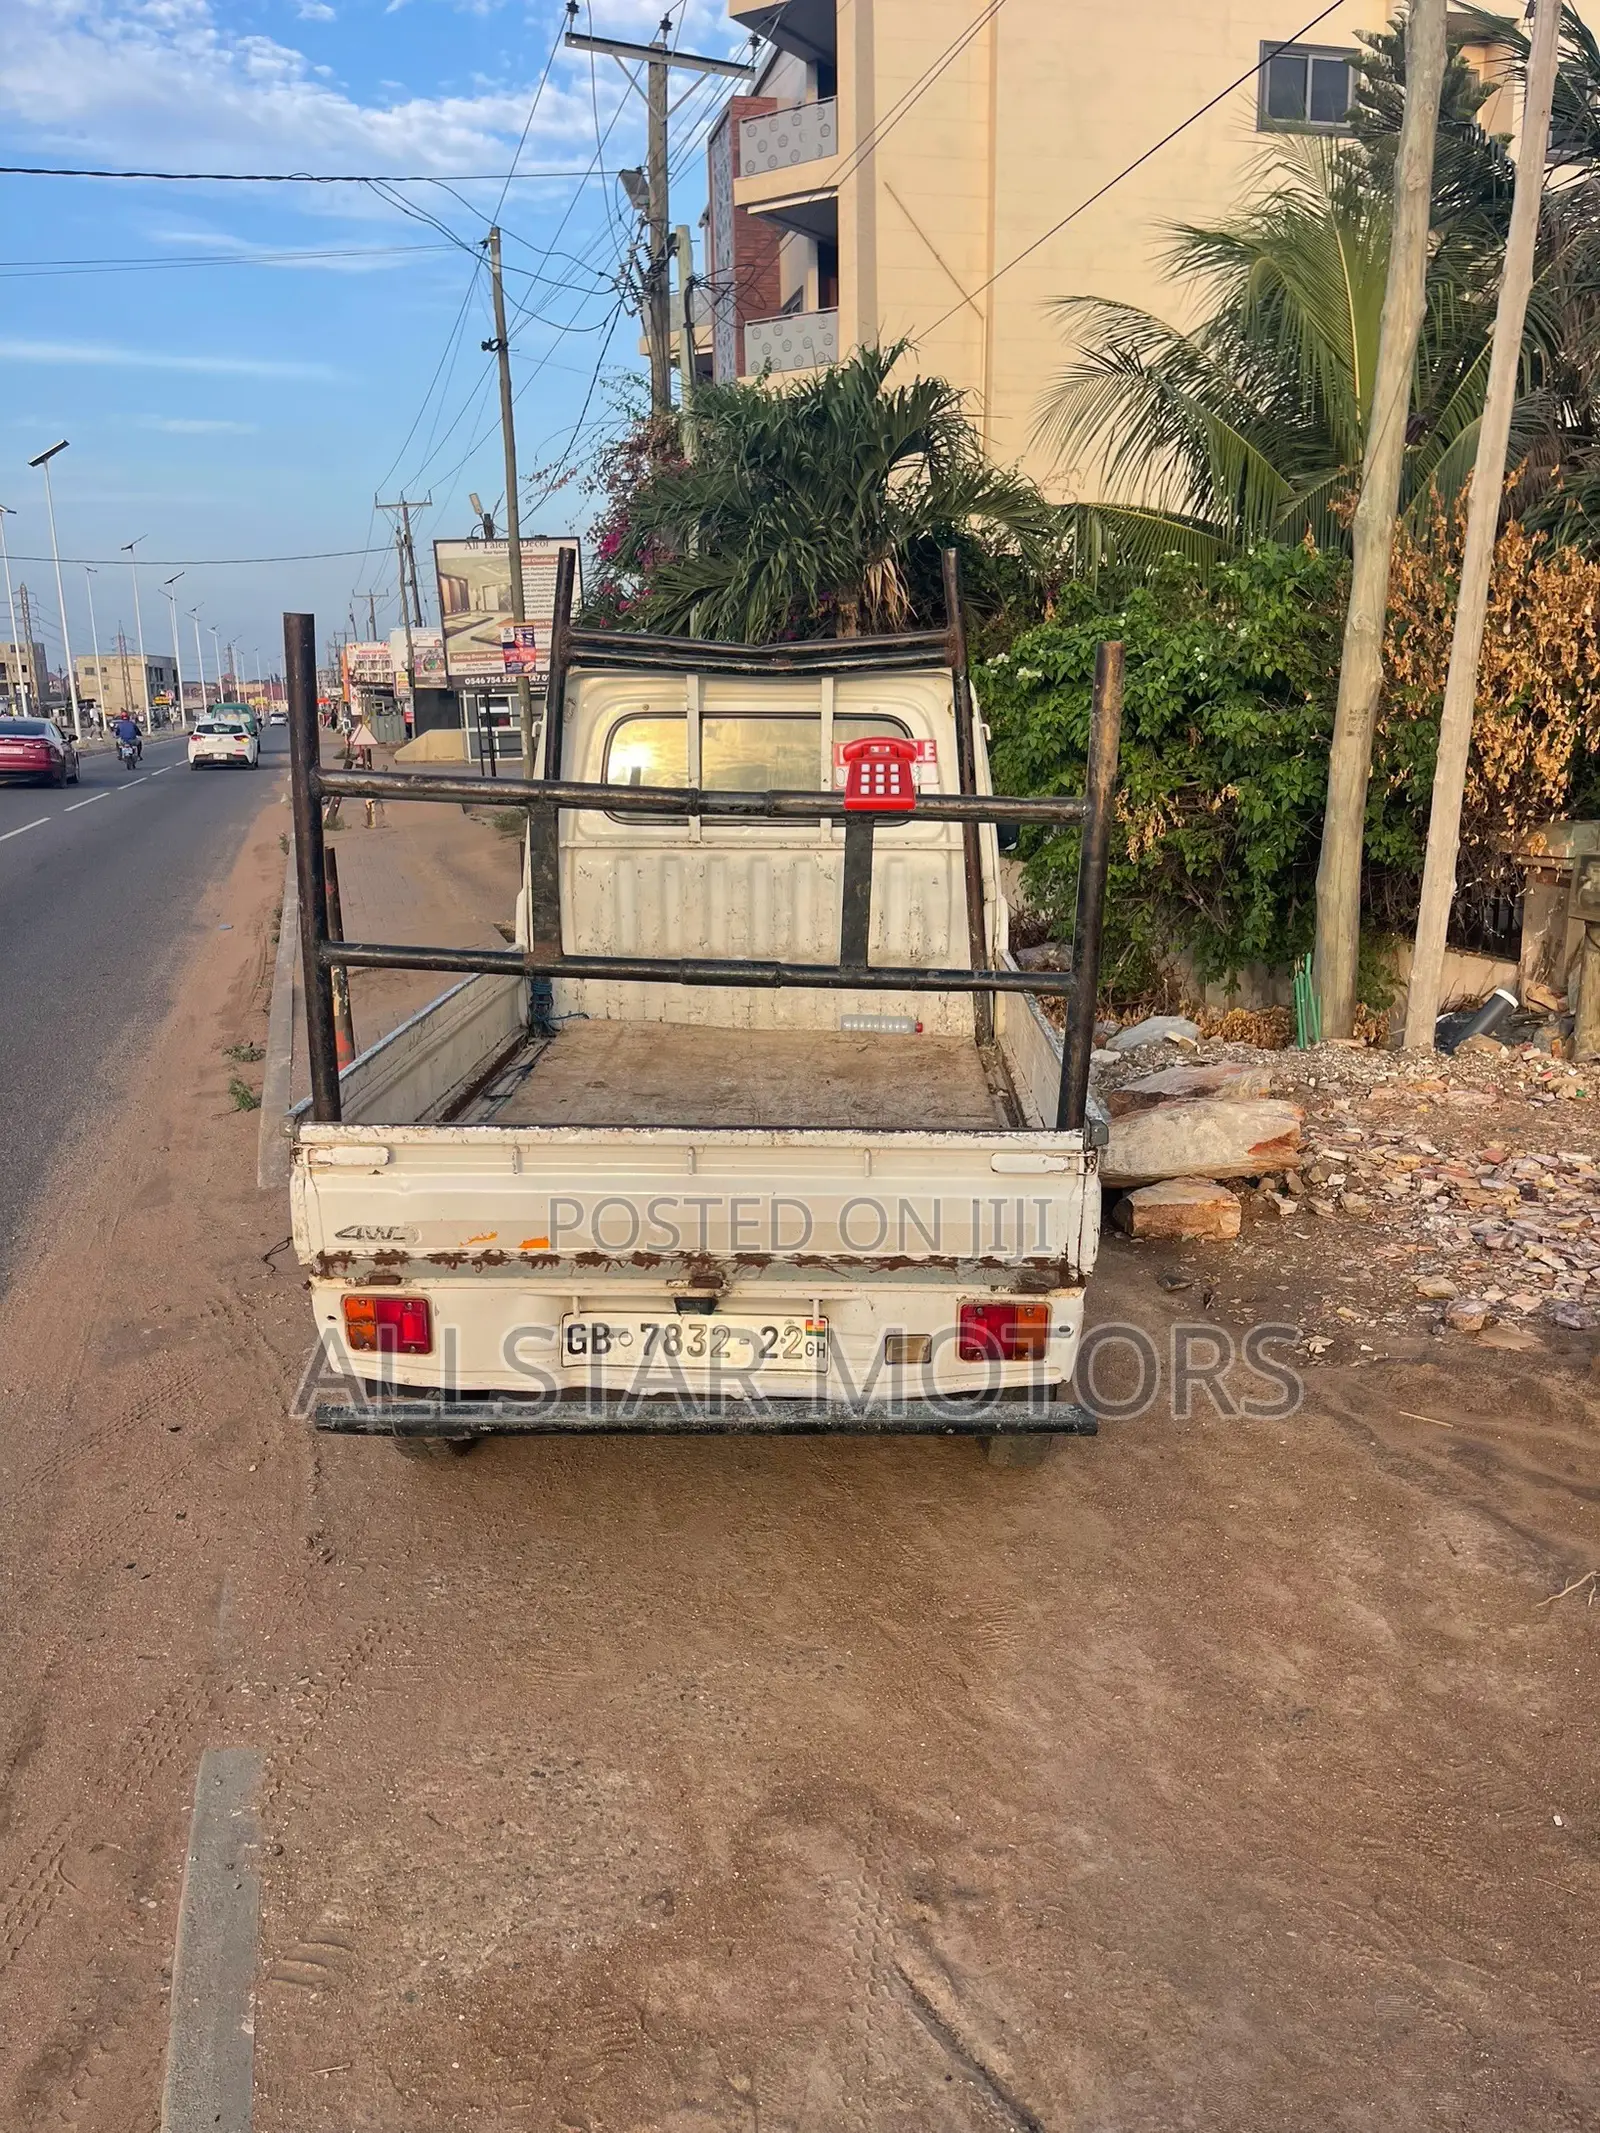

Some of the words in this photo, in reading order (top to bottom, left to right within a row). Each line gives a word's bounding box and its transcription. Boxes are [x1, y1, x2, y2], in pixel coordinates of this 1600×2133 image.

[464, 677, 486, 685] 0546
[486, 676, 501, 684] 754
[567, 1322, 612, 1356] GB
[805, 1341, 826, 1359] GH
